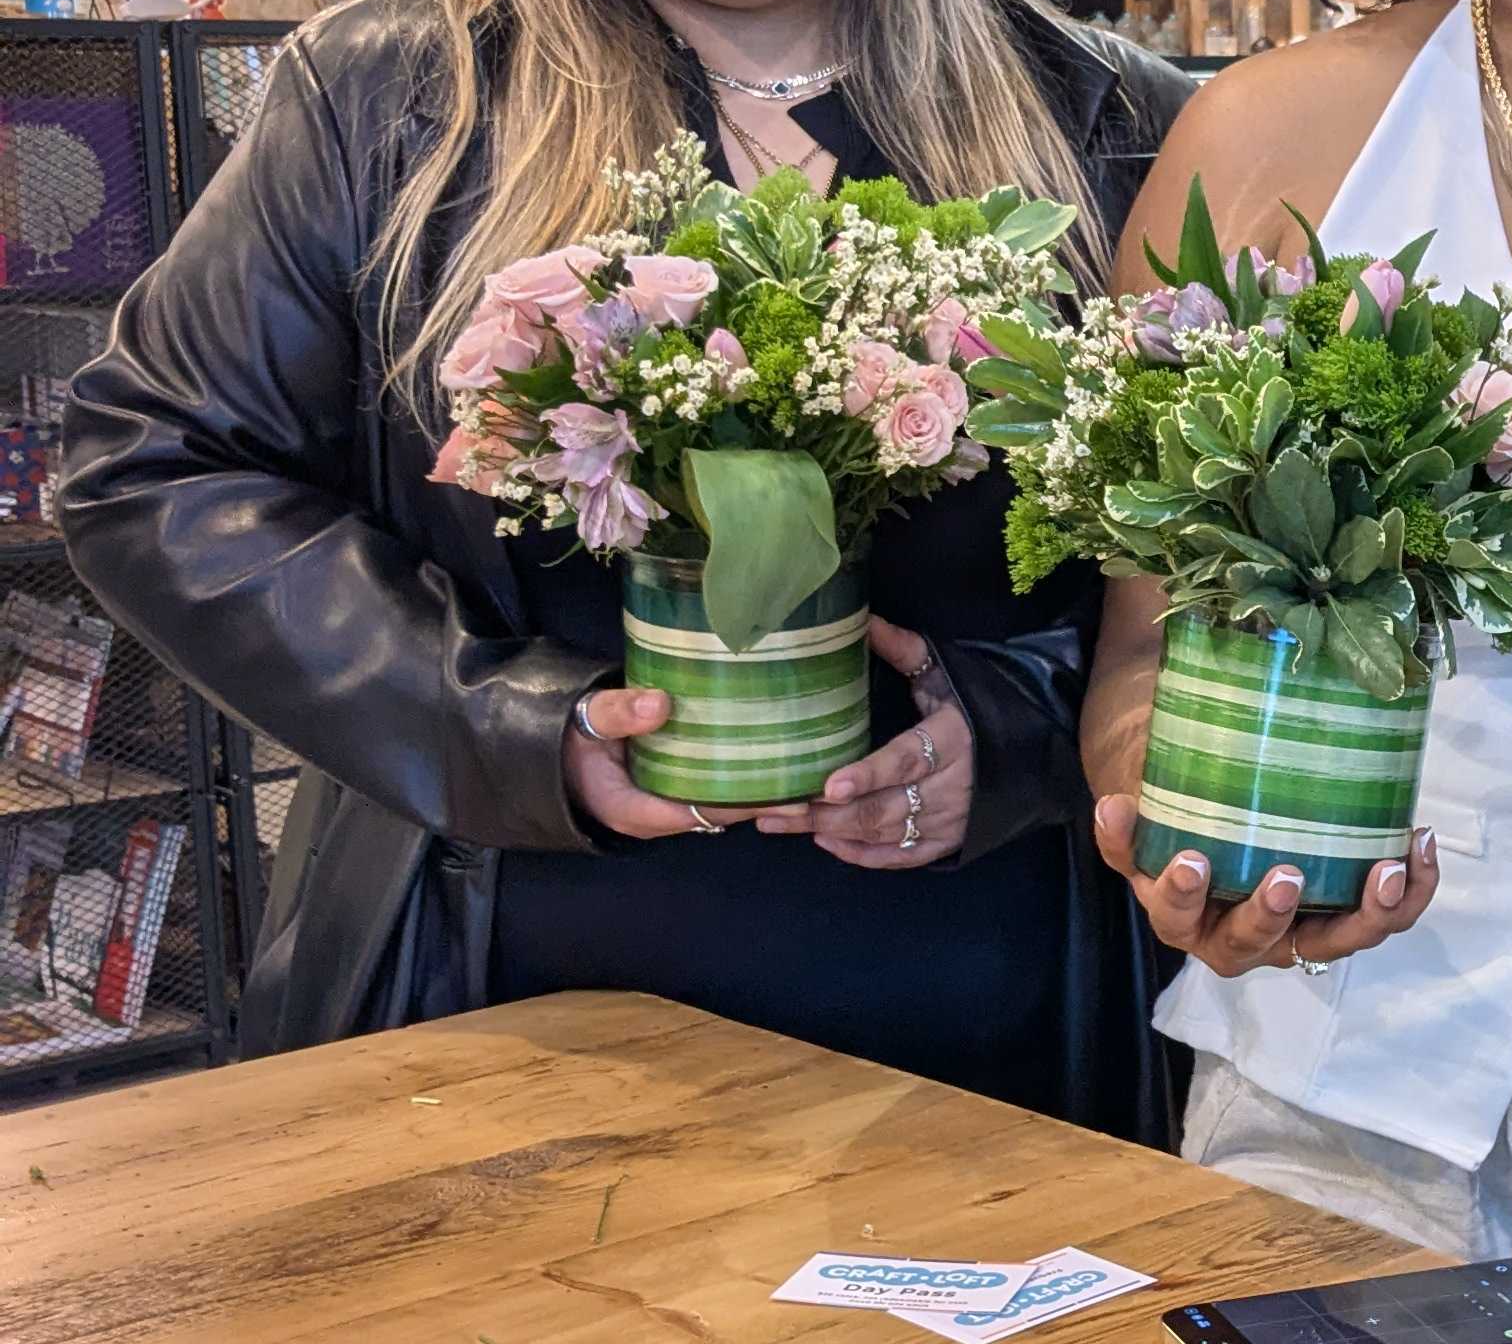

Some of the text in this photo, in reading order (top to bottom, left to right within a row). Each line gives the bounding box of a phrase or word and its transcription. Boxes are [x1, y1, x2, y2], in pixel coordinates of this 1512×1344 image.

[827, 1266, 999, 1286] CRAFT LOFT
[843, 1283, 957, 1298] Day Pass
[1031, 1272, 1098, 1301] CRAFT
